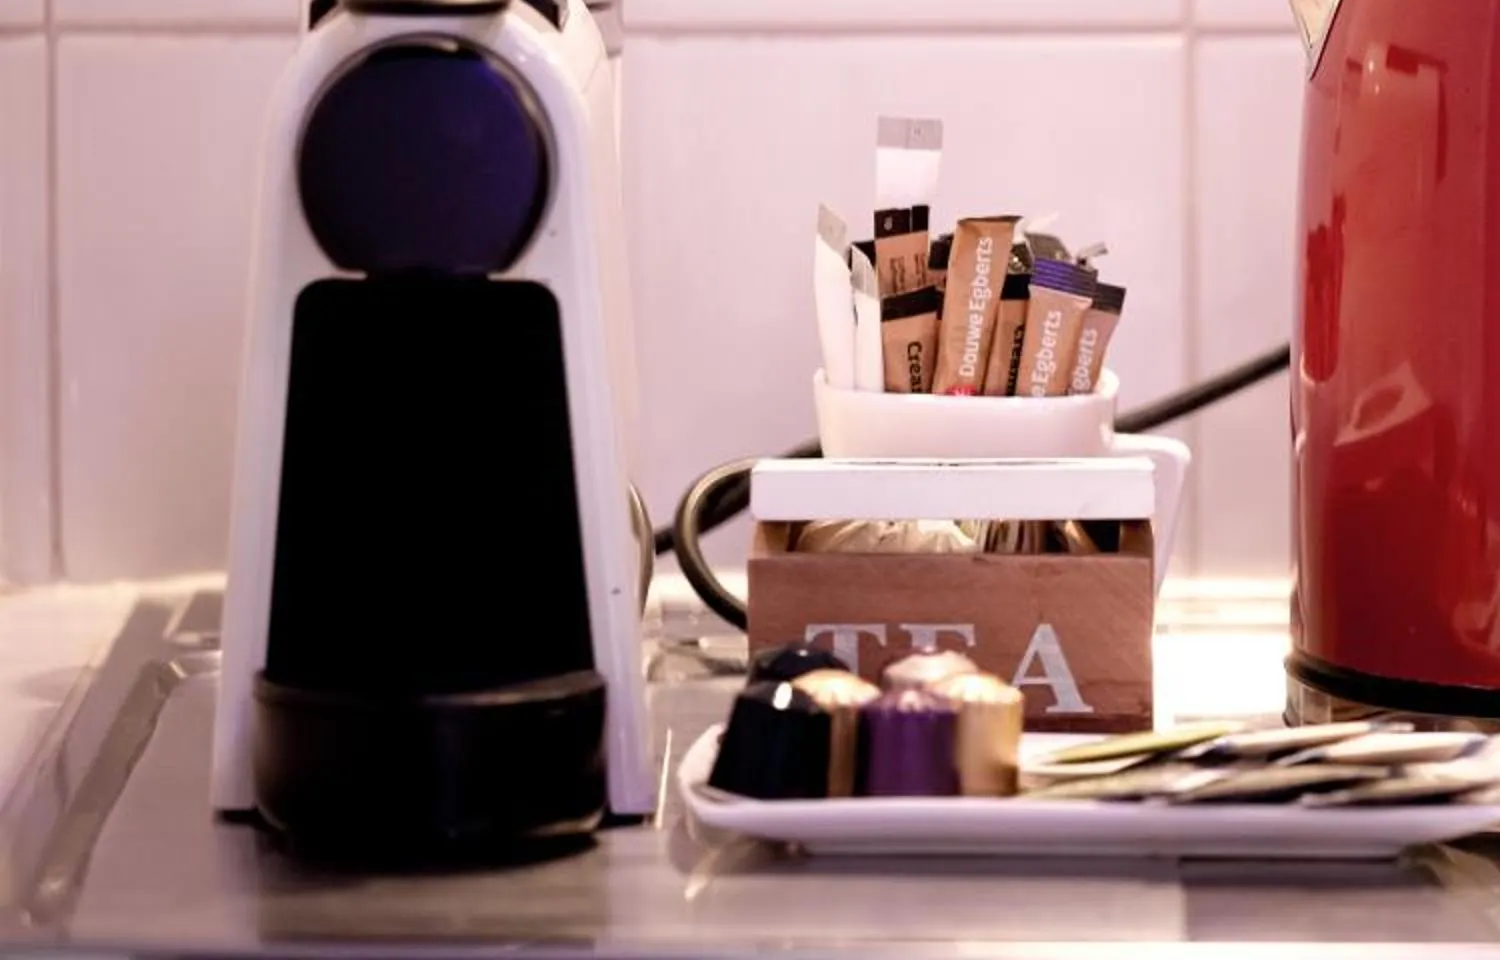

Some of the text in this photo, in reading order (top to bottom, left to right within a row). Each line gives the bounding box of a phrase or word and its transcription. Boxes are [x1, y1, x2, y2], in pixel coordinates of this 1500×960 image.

[969, 236, 994, 311] Egberts
[958, 313, 984, 377] Douwe
[1031, 310, 1062, 384] Egberts
[1071, 328, 1098, 391] gberts
